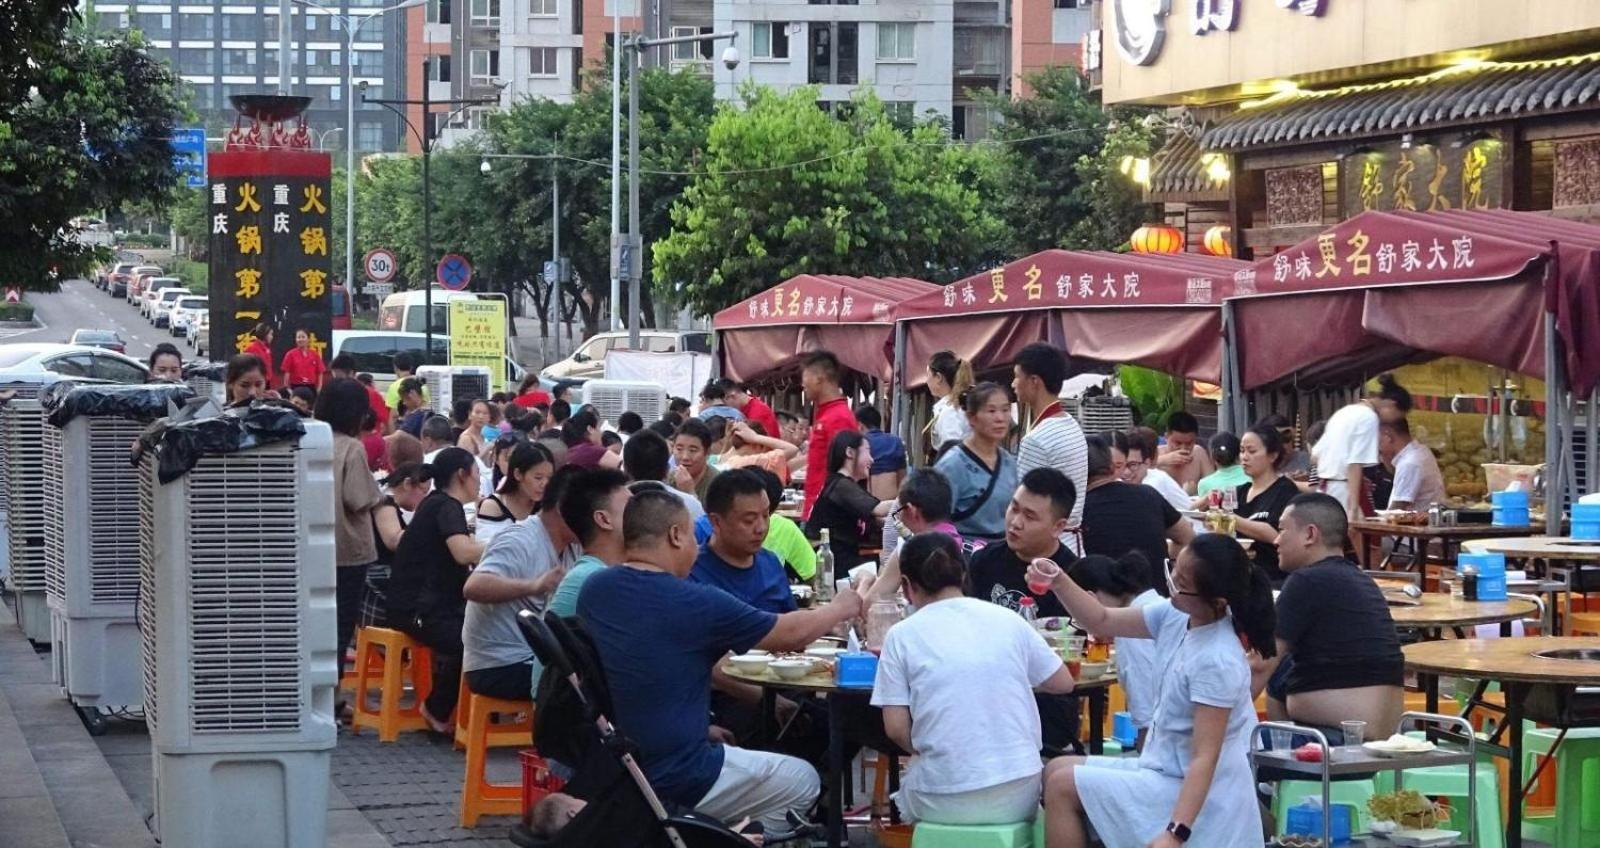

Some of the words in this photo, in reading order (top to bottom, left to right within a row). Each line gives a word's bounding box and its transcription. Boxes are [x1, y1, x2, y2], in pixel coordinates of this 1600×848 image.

[1360, 147, 1490, 211] 舒家大院
[211, 183, 229, 235] 重庆
[273, 183, 290, 234] 重庆
[371, 259, 390, 272] 30t
[1273, 229, 1475, 283] 舒味更名舒家大院
[749, 287, 854, 319] 舒味更名舒家大院
[943, 264, 1141, 307] 舒味更名舒家大院
